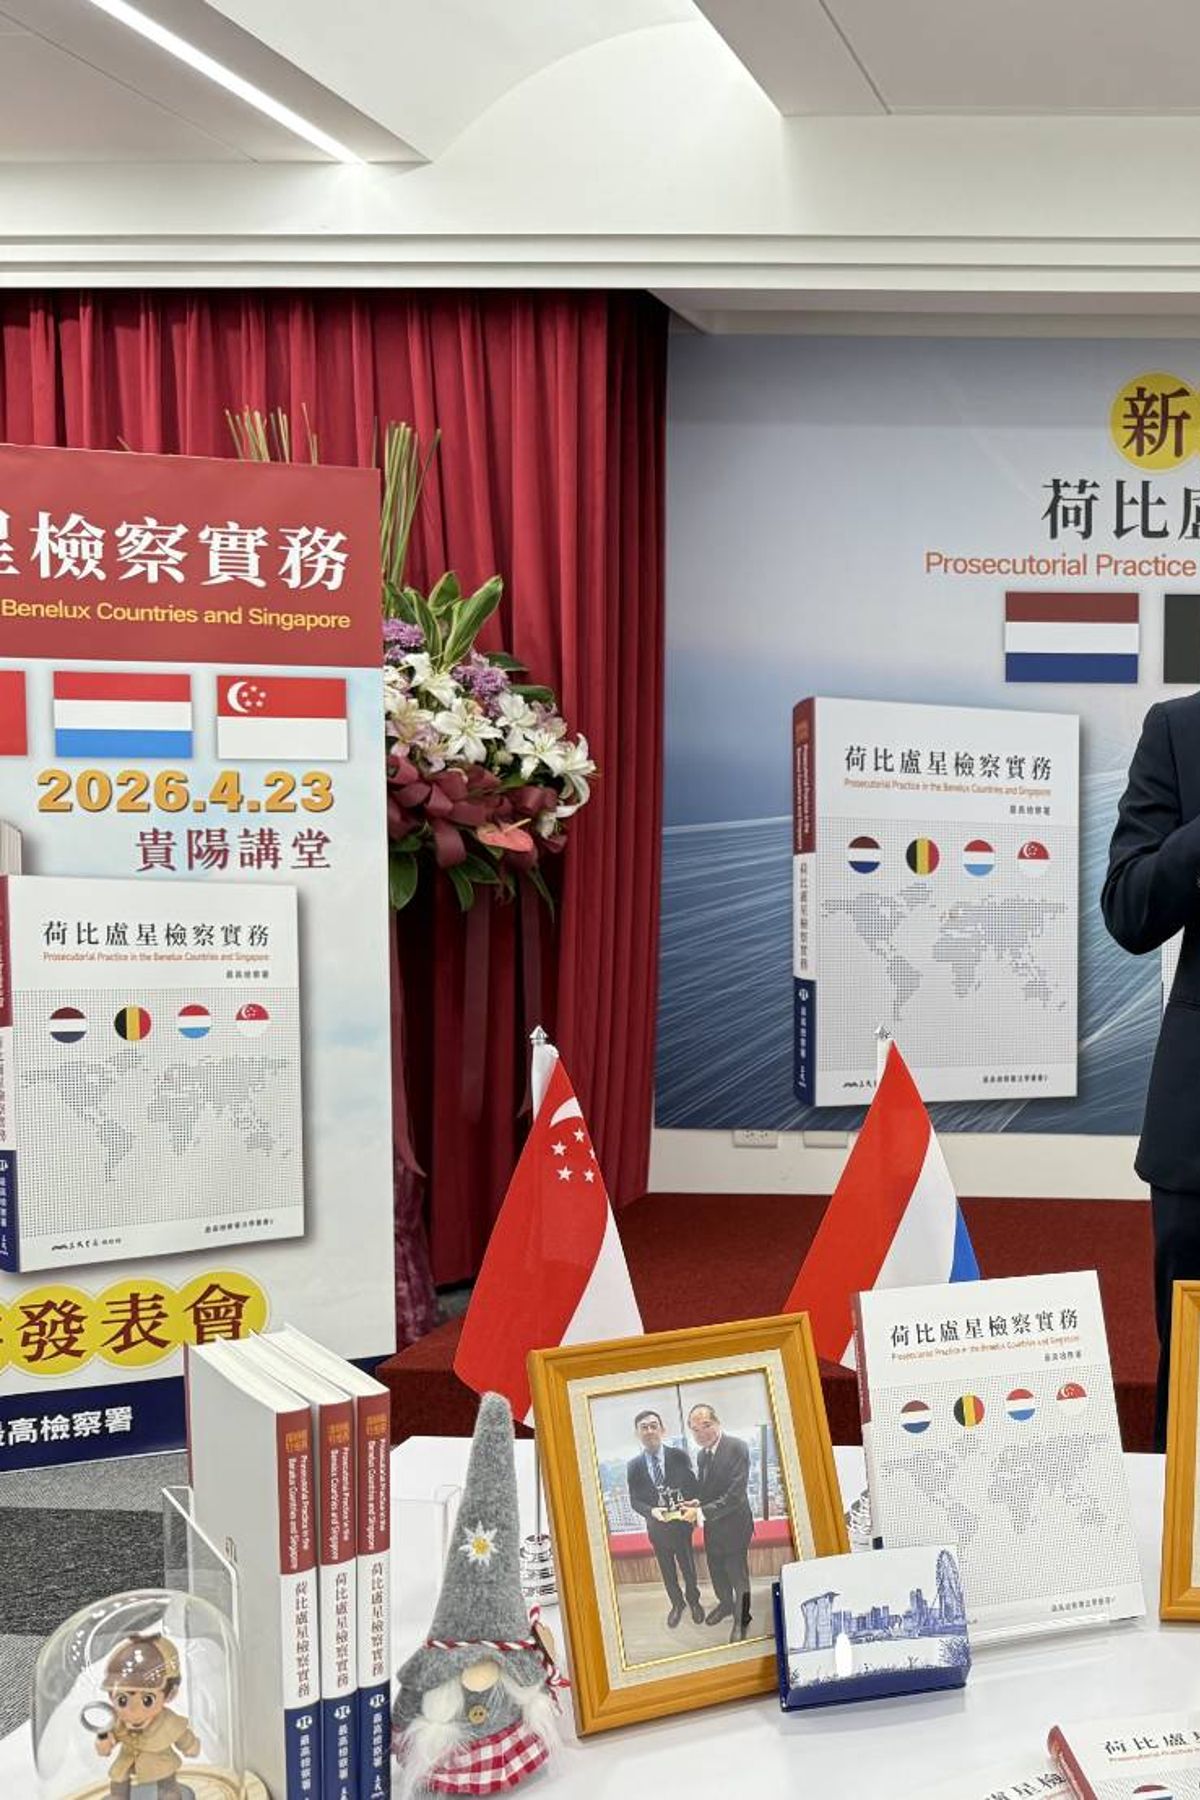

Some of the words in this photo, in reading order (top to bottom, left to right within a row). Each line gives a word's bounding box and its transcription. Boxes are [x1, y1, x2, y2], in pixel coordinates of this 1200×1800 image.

[925, 551, 1087, 577] Prosecutorial
[1096, 553, 1196, 577] Practice
[1, 599, 91, 620] Benelux
[97, 602, 199, 624] Countries
[204, 605, 243, 625] and
[248, 606, 351, 632] Singapore
[845, 745, 1051, 781] 荷比盧星檢察實務
[37, 769, 335, 813] 2026.4.23
[135, 827, 333, 872] 貴陽講堂
[42, 920, 269, 947] 荷比盧星檢察實務
[0, 1283, 251, 1363] 發表會
[891, 1308, 1078, 1348] 荷比盧星檢察實務
[0, 1406, 133, 1446] 高檢察署
